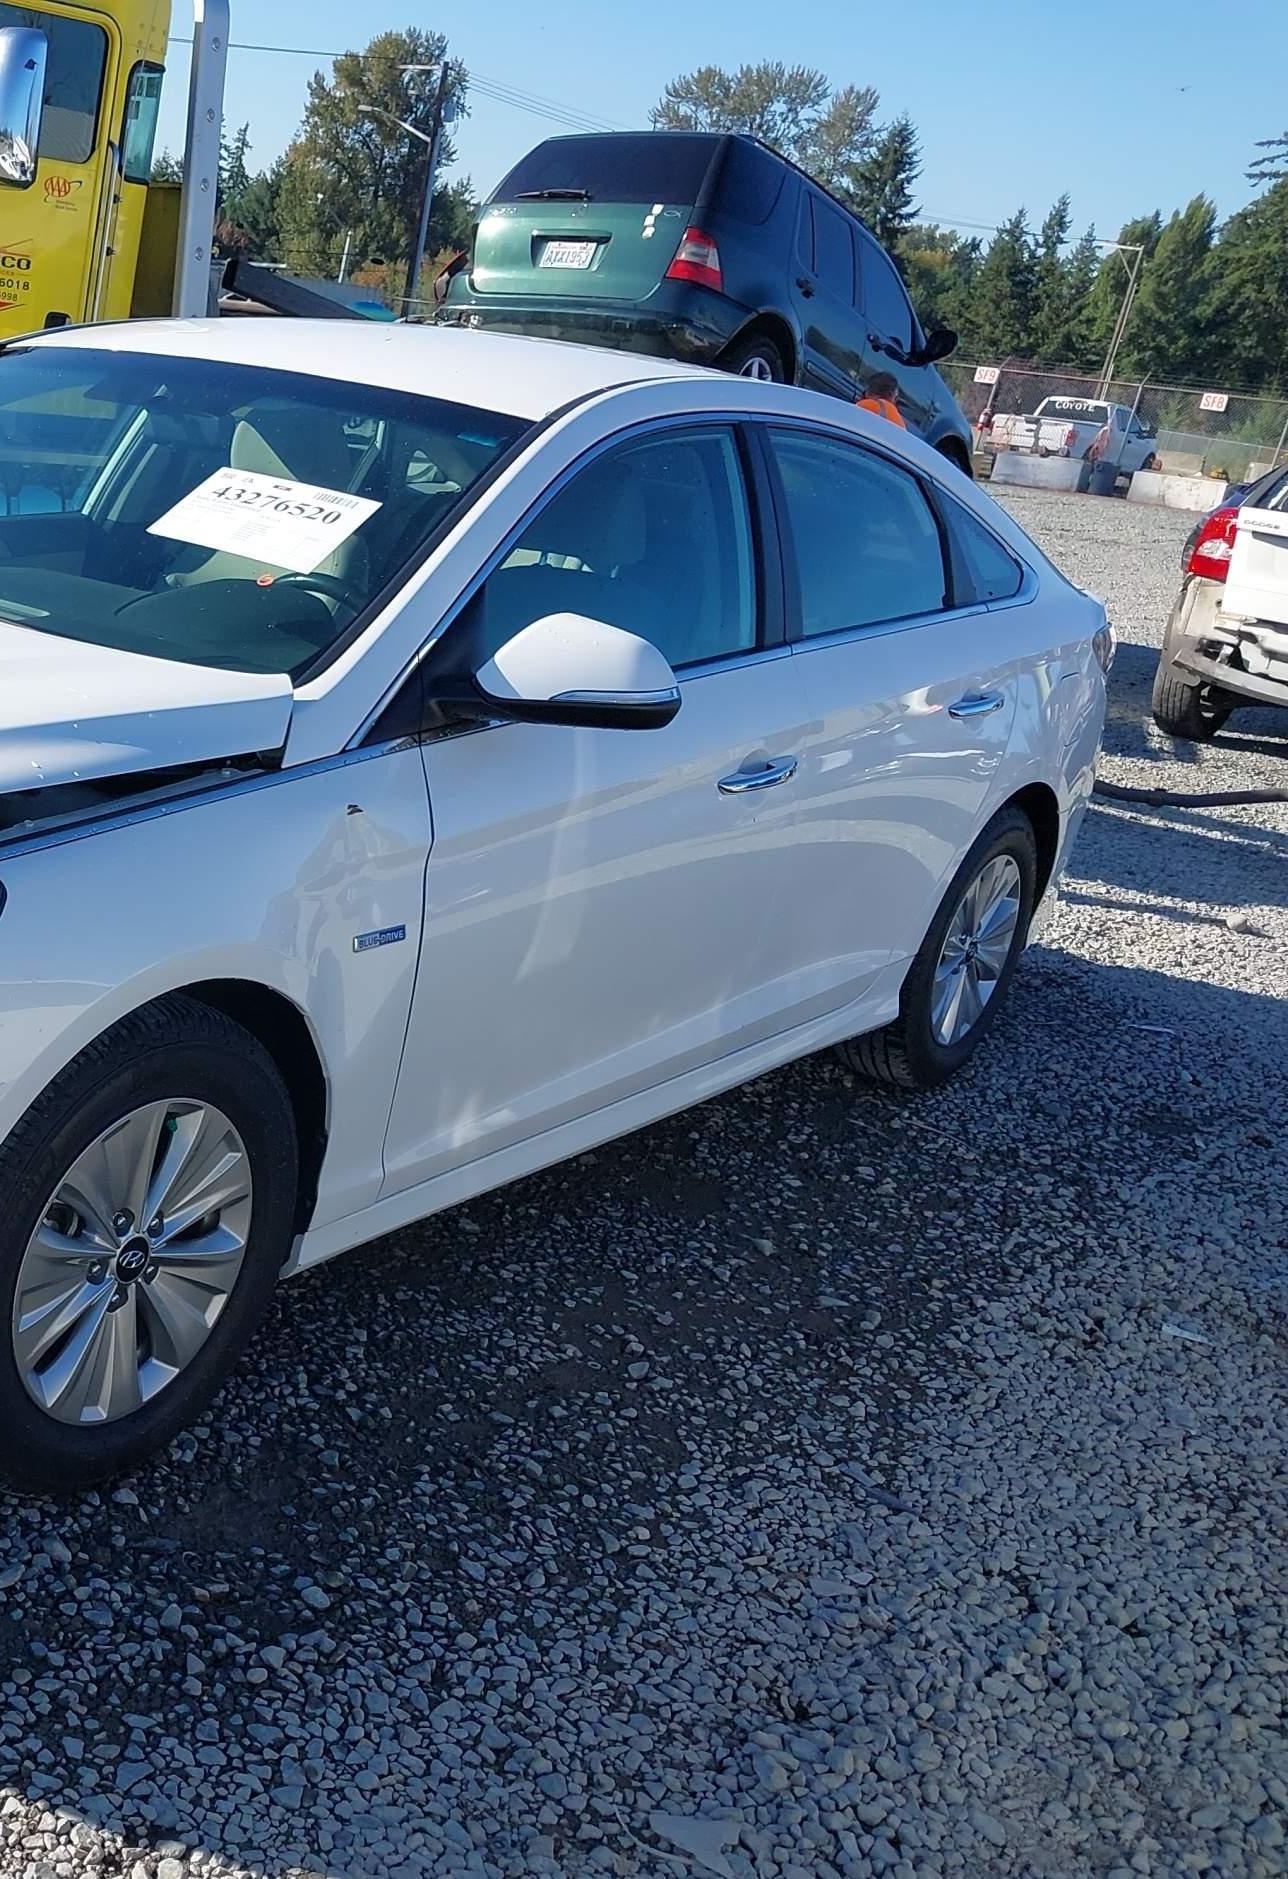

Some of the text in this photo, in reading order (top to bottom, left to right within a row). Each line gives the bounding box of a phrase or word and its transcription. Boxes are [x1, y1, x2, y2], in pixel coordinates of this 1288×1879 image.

[977, 369, 997, 381] SF9
[1055, 401, 1096, 413] COYOTE
[1203, 395, 1225, 409] SF8
[211, 486, 342, 525] 43276520
